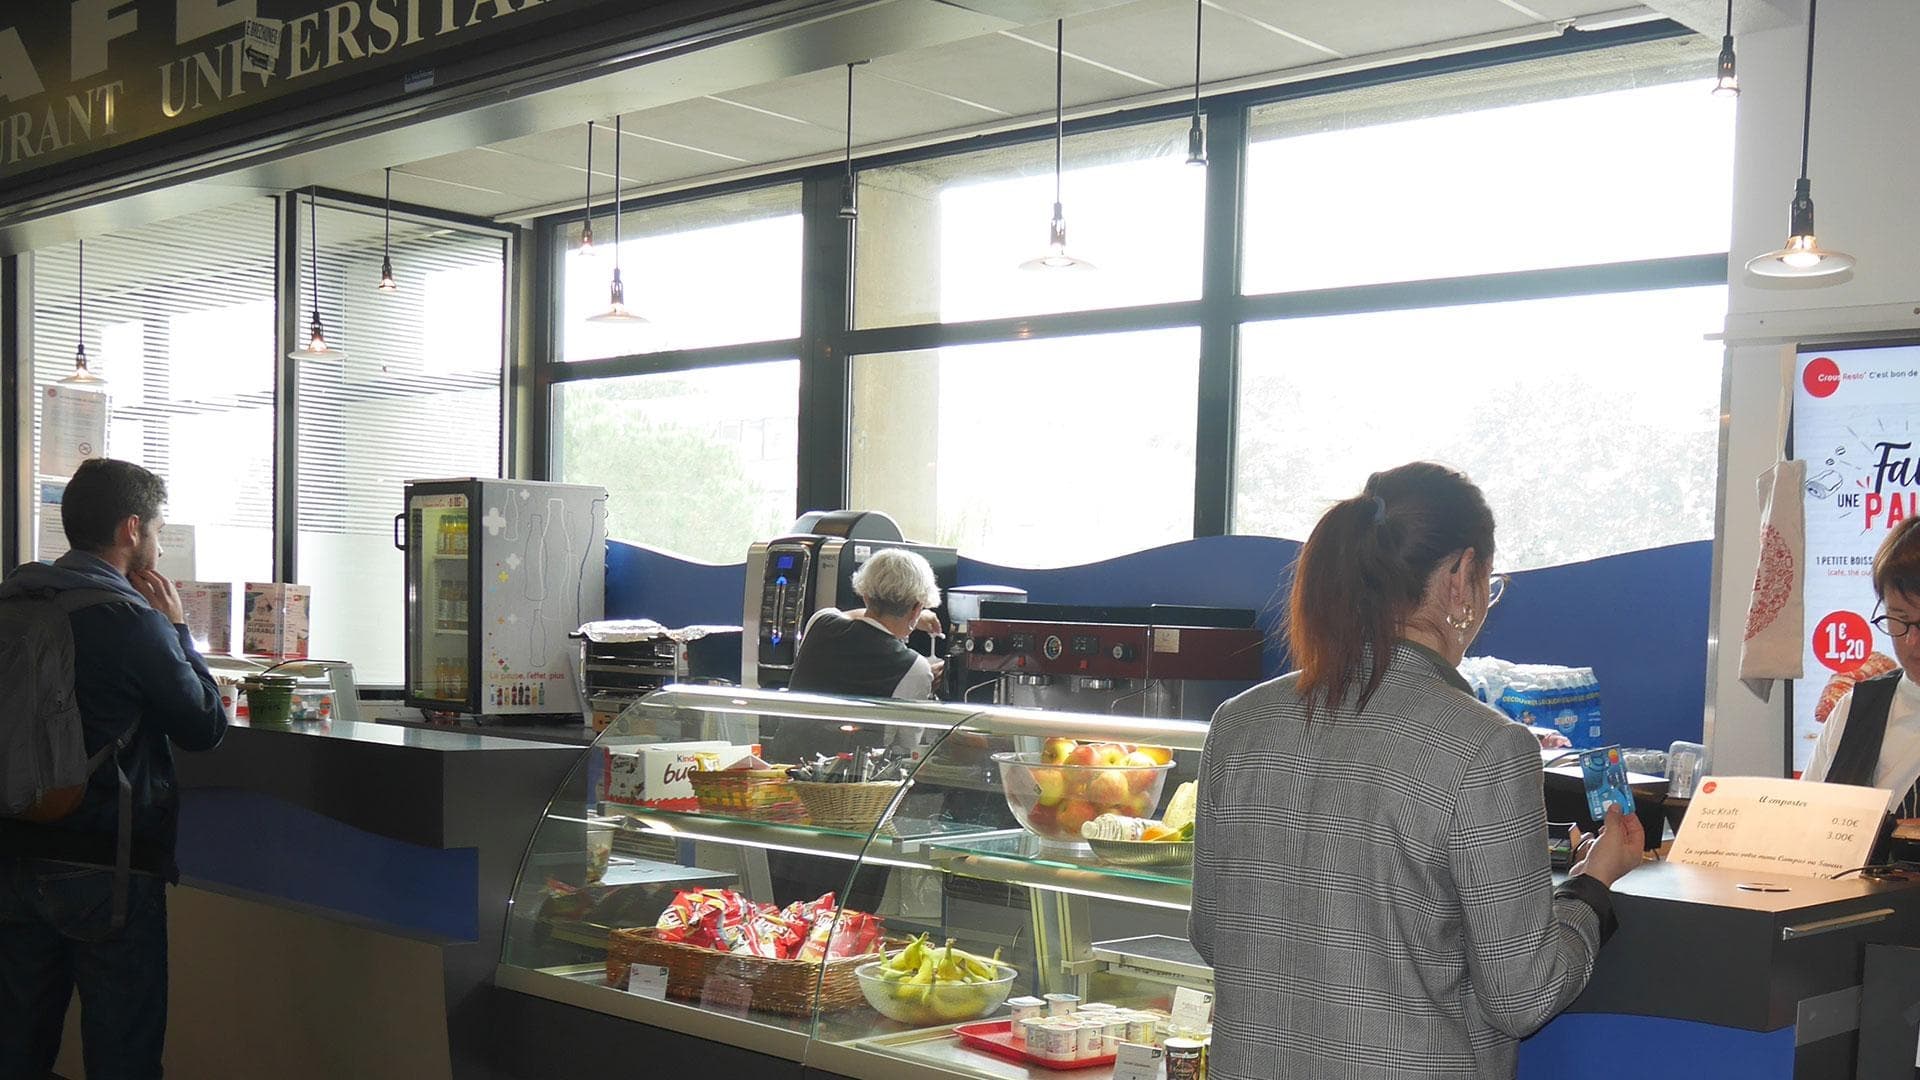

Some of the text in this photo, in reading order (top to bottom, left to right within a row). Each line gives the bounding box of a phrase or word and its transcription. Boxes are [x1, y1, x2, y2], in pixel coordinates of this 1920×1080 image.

[0, 79, 124, 165] RANT
[1869, 371, 1888, 379] C'est
[1907, 369, 1918, 377] de
[1838, 493, 1860, 508] UNE
[1822, 556, 1848, 565] PETITE
[1851, 556, 1873, 565] BOISS
[1832, 817, 1860, 828] 0.10€
[1717, 822, 1736, 830] BAG
[1826, 831, 1854, 841] 3.00€
